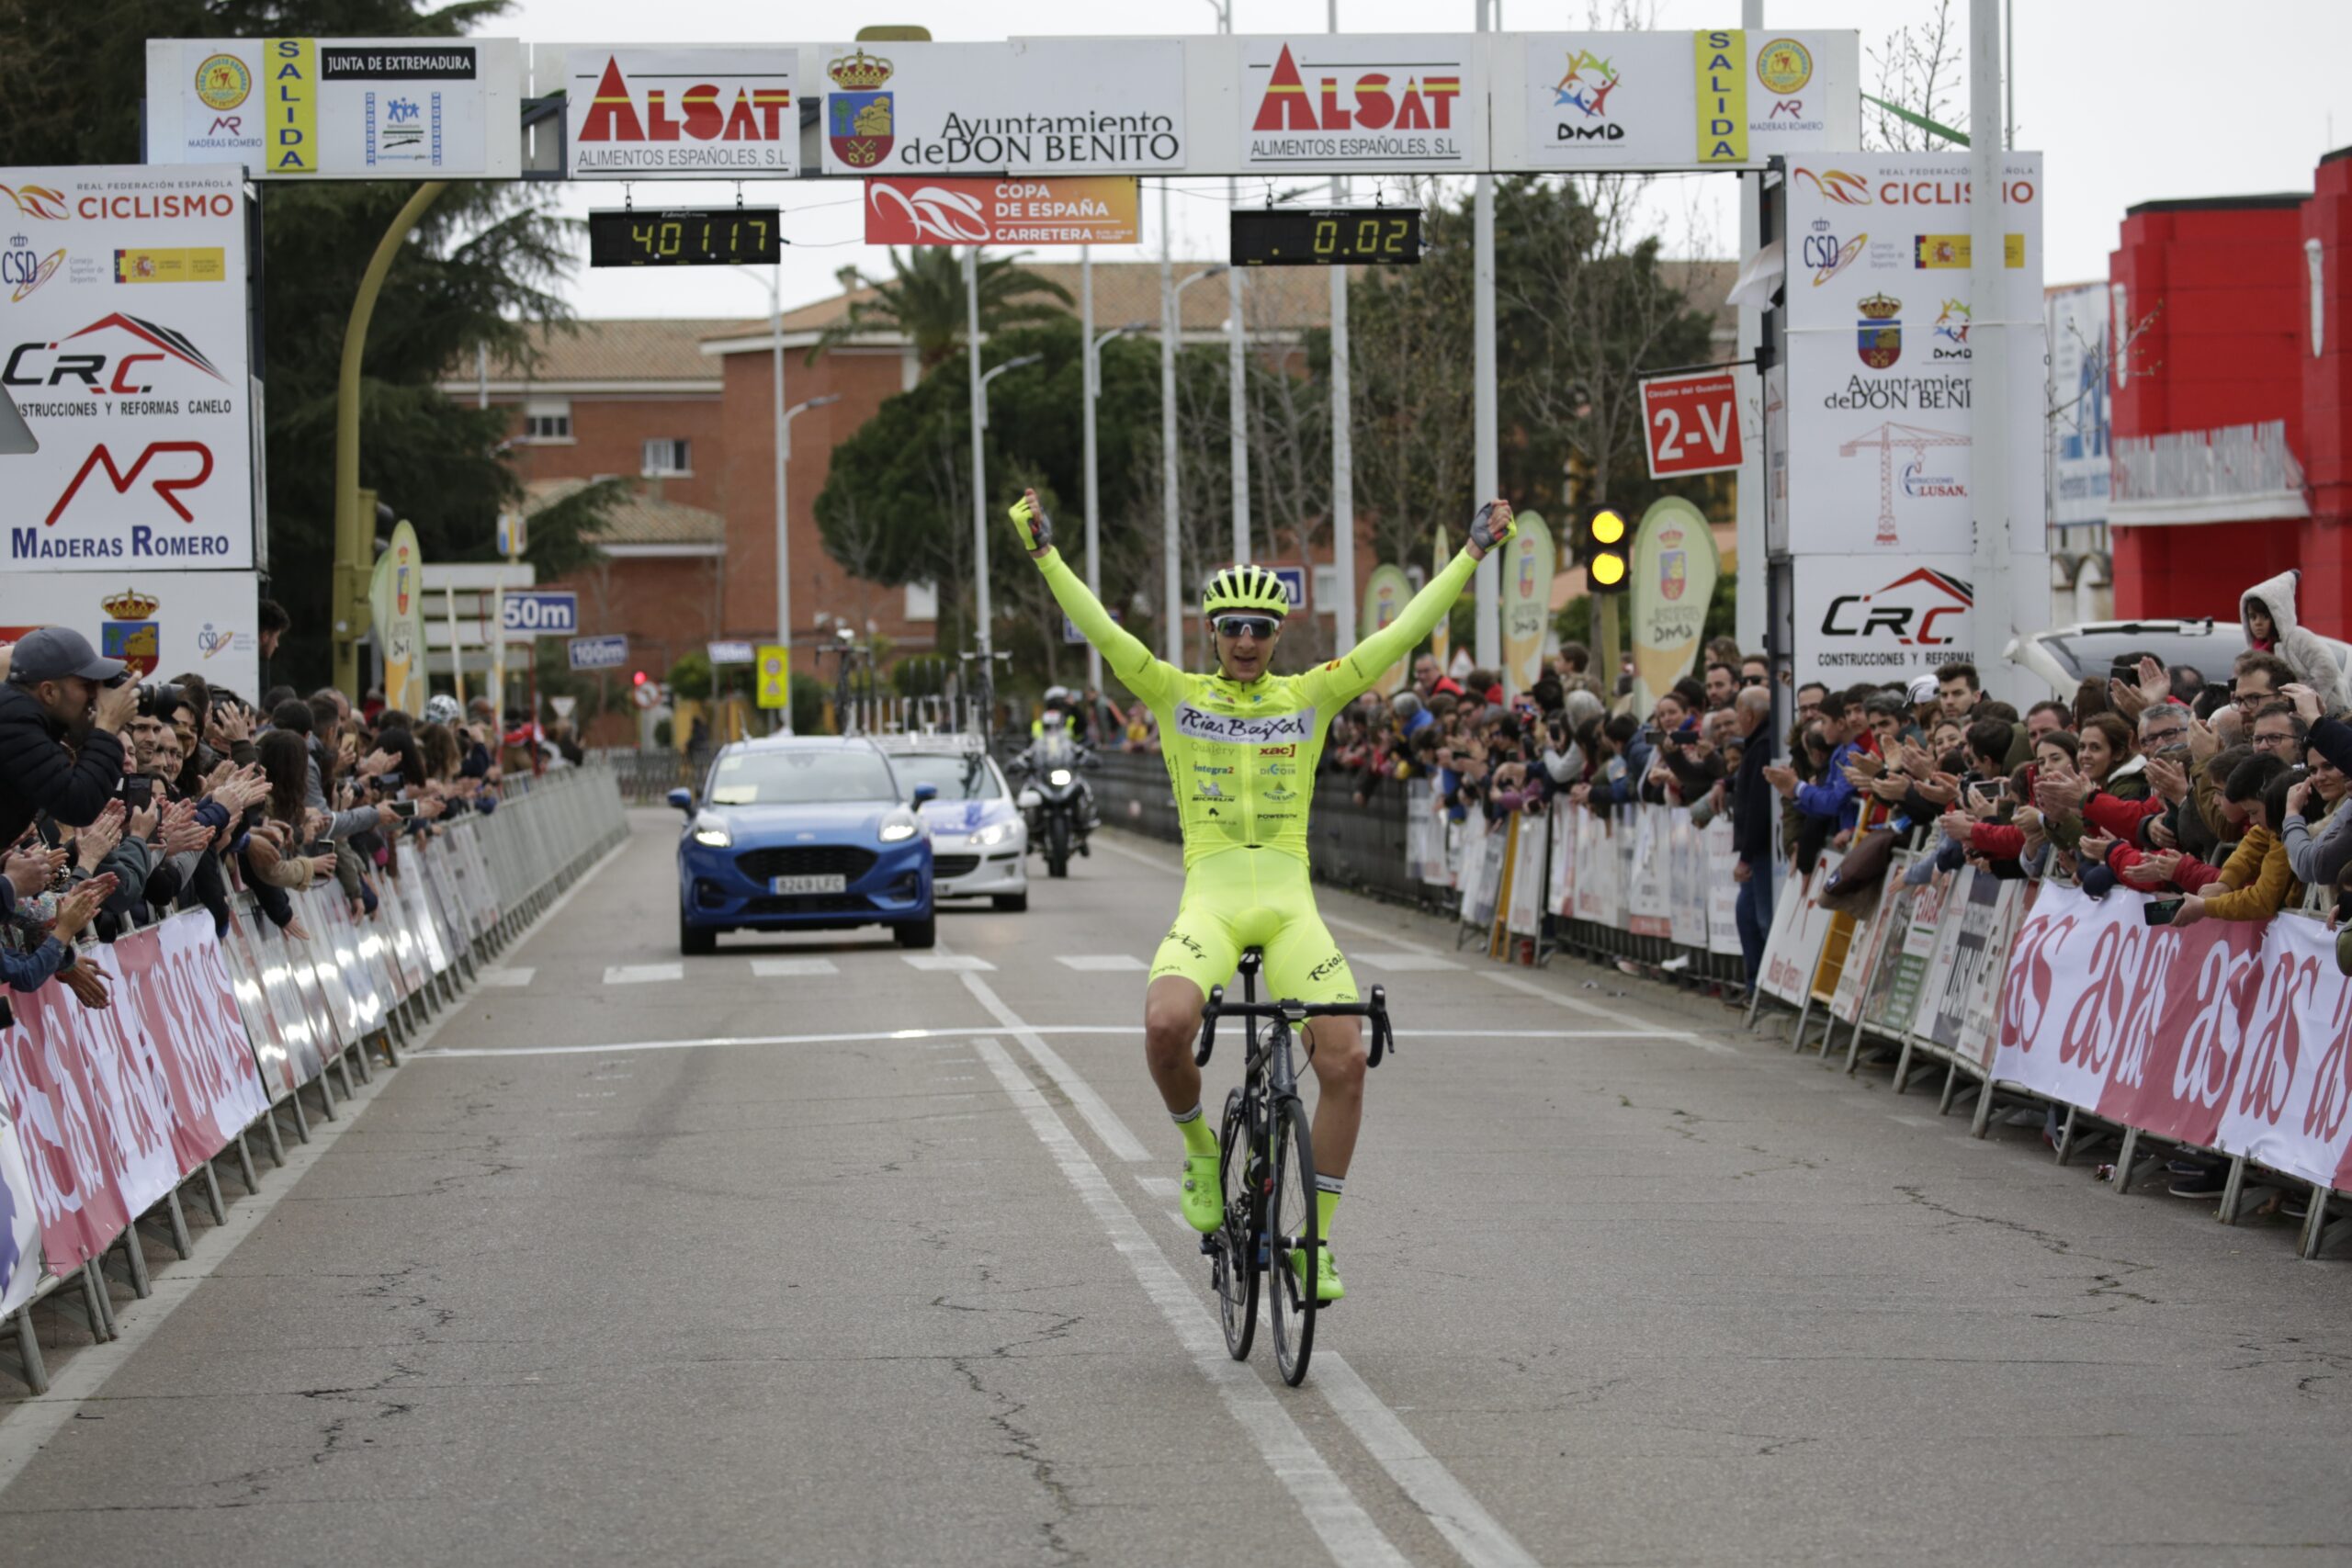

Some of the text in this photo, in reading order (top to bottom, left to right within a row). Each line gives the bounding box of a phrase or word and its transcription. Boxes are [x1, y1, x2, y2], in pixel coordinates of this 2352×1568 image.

[327, 55, 471, 73] JUNTA DE EXTREMADURA
[578, 54, 790, 141] ALSAT
[1252, 42, 1461, 131] ALSAT
[1708, 32, 1736, 158] SALIDA
[277, 41, 304, 167] SALIDA
[941, 110, 1173, 146] Ayuntamiento
[1557, 122, 1624, 141] DMD
[1749, 121, 1824, 131] MADERAS ROMERO
[188, 138, 264, 148] MADERAS ROMERO
[1045, 132, 1180, 164] BENITO
[1251, 136, 1462, 157] ALIMENTOS ESPAÑOLES, S.L.
[579, 146, 792, 168] ALIMENTOS ESPAÑOLES, S.L.
[1909, 166, 1972, 175] FEDERACIÓ
[77, 179, 233, 191] REAL FEDERACIÓN ESPAÑOLA
[995, 184, 1051, 199] COPA
[78, 194, 234, 220] CICLISMO
[995, 197, 1109, 218] DE ESPAÑA
[995, 228, 1092, 242] CARRETERA
[1804, 235, 1838, 268] CSD
[2, 251, 38, 284] CSD
[105, 401, 112, 413] Y
[120, 400, 180, 415] REFORMAS
[188, 399, 232, 413] CANELO
[1919, 390, 1972, 409] BENI
[1654, 401, 1732, 461] 2-V
[12, 525, 230, 559] MADERAS ROMERO
[503, 597, 571, 627] 50m
[574, 643, 626, 665] 100m
[1818, 652, 1905, 667] CONSTRUCCIONES
[1912, 652, 1919, 666] Y
